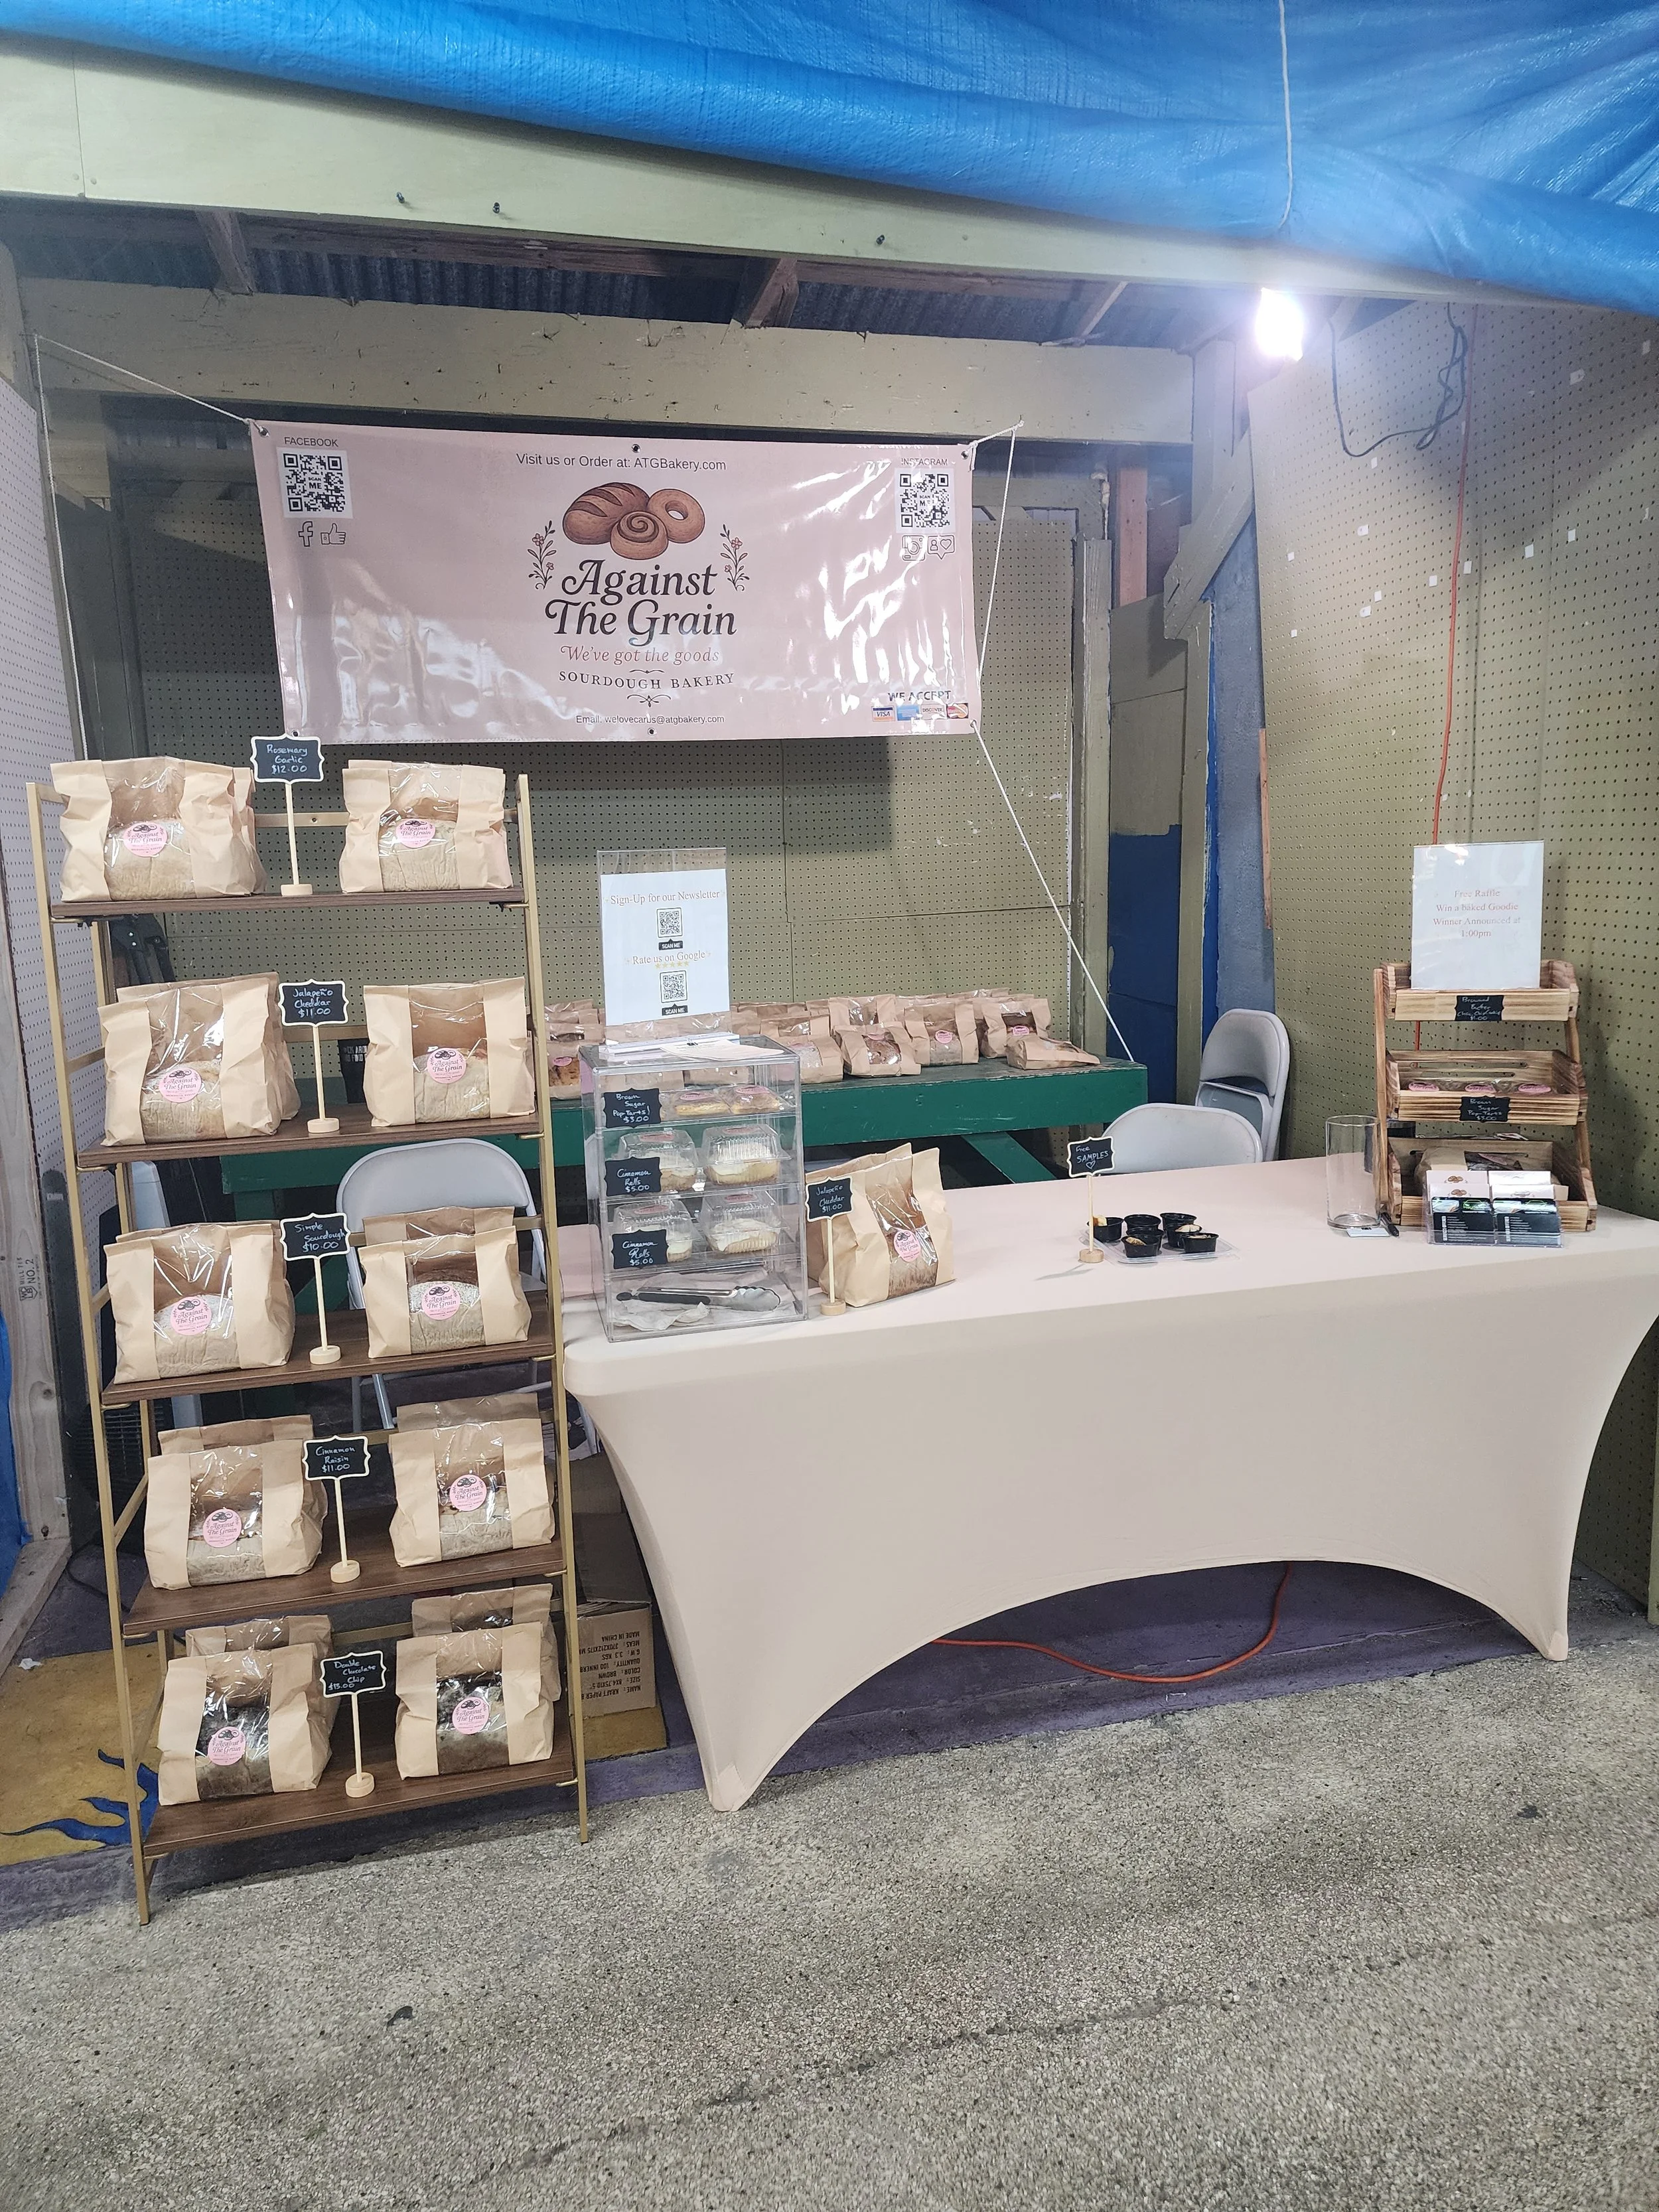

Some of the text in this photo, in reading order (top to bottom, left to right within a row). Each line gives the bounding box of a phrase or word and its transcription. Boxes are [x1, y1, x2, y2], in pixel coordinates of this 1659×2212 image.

[284, 437, 338, 447] FACEBOOK
[516, 453, 726, 472] Visit us or Order at: ATGBakery.com
[561, 559, 718, 606] Against
[545, 599, 737, 647] The Grain
[561, 644, 719, 666] We've got the goods
[559, 671, 735, 690] SOURDOUGH BAKERY
[908, 690, 951, 701] ACCEPT
[575, 715, 602, 723] Email:
[266, 744, 308, 757] Rosemary
[274, 755, 303, 764] Garlic
[271, 764, 307, 775] $12.00
[610, 893, 646, 906] Sign-Up
[648, 893, 660, 903] for
[678, 890, 720, 901] Newsletter
[1464, 917, 1511, 925] Announced
[632, 956, 651, 965] Rate
[676, 950, 705, 962] Google
[294, 997, 331, 1008] Cheddar
[298, 1008, 331, 1018] $11.00
[1076, 1151, 1109, 1163] SAMPLES
[616, 1168, 652, 1178] Cinnamon
[624, 1177, 641, 1186] Rolls
[819, 1195, 845, 1207] Cheddar
[822, 1203, 843, 1213] $11.00
[294, 1222, 323, 1233] Simple
[304, 1228, 345, 1242] Sourdough
[302, 1241, 339, 1253] $10.00
[628, 1248, 650, 1259] Rolls
[630, 1258, 654, 1266] $5.00
[27, 1267, 36, 1284] NO.
[439, 1300, 457, 1309] Grain
[178, 1309, 203, 1318] Against
[188, 1314, 208, 1323] Grain
[315, 1446, 356, 1456] Cinnamon
[324, 1455, 349, 1464] Raisin
[321, 1463, 350, 1473] $11.00
[457, 1486, 479, 1495] Against
[334, 1659, 360, 1668] Double
[342, 1664, 376, 1676] Chocolate
[598, 1670, 617, 1679] BROWN
[586, 1691, 602, 1700] PAPER
[603, 1688, 619, 1698] KRAFT
[468, 1714, 485, 1722] Grain
